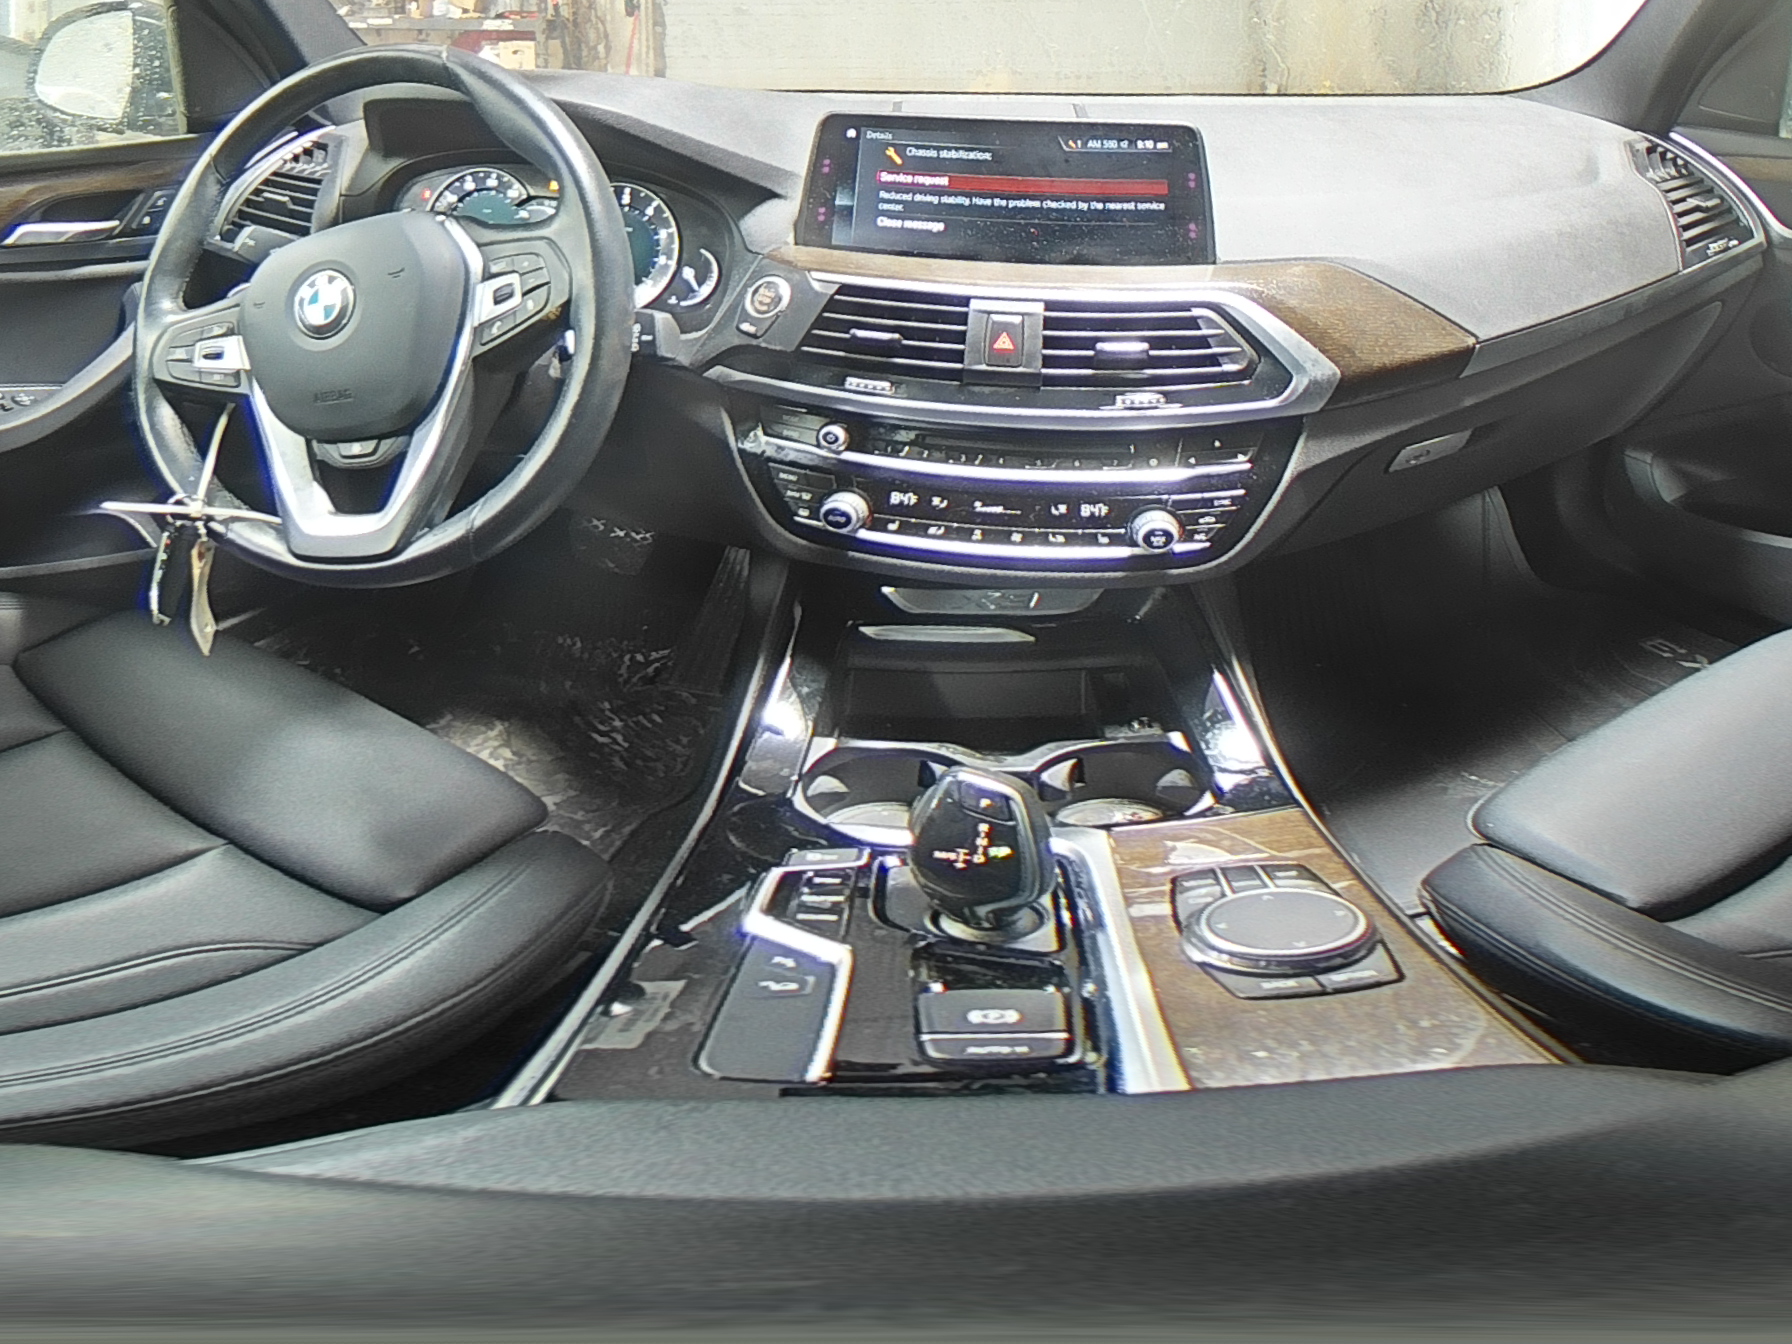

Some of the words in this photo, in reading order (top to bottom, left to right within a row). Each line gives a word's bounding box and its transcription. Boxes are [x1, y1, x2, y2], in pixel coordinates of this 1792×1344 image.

[865, 130, 893, 140] Details
[1087, 139, 1102, 149] AM
[905, 146, 938, 158] Chassis
[879, 171, 914, 184] Service
[914, 173, 950, 187] request
[878, 190, 912, 202] Reduced
[913, 192, 939, 205] driving
[972, 196, 992, 206] Have
[993, 197, 1007, 207] the
[1008, 198, 1041, 209] problem
[1042, 199, 1077, 209] checked
[1078, 200, 1088, 211] by
[1090, 200, 1104, 210] the
[1105, 201, 1136, 211] nearest
[1136, 201, 1166, 211] service
[876, 216, 903, 228] Close
[903, 218, 946, 233] message
